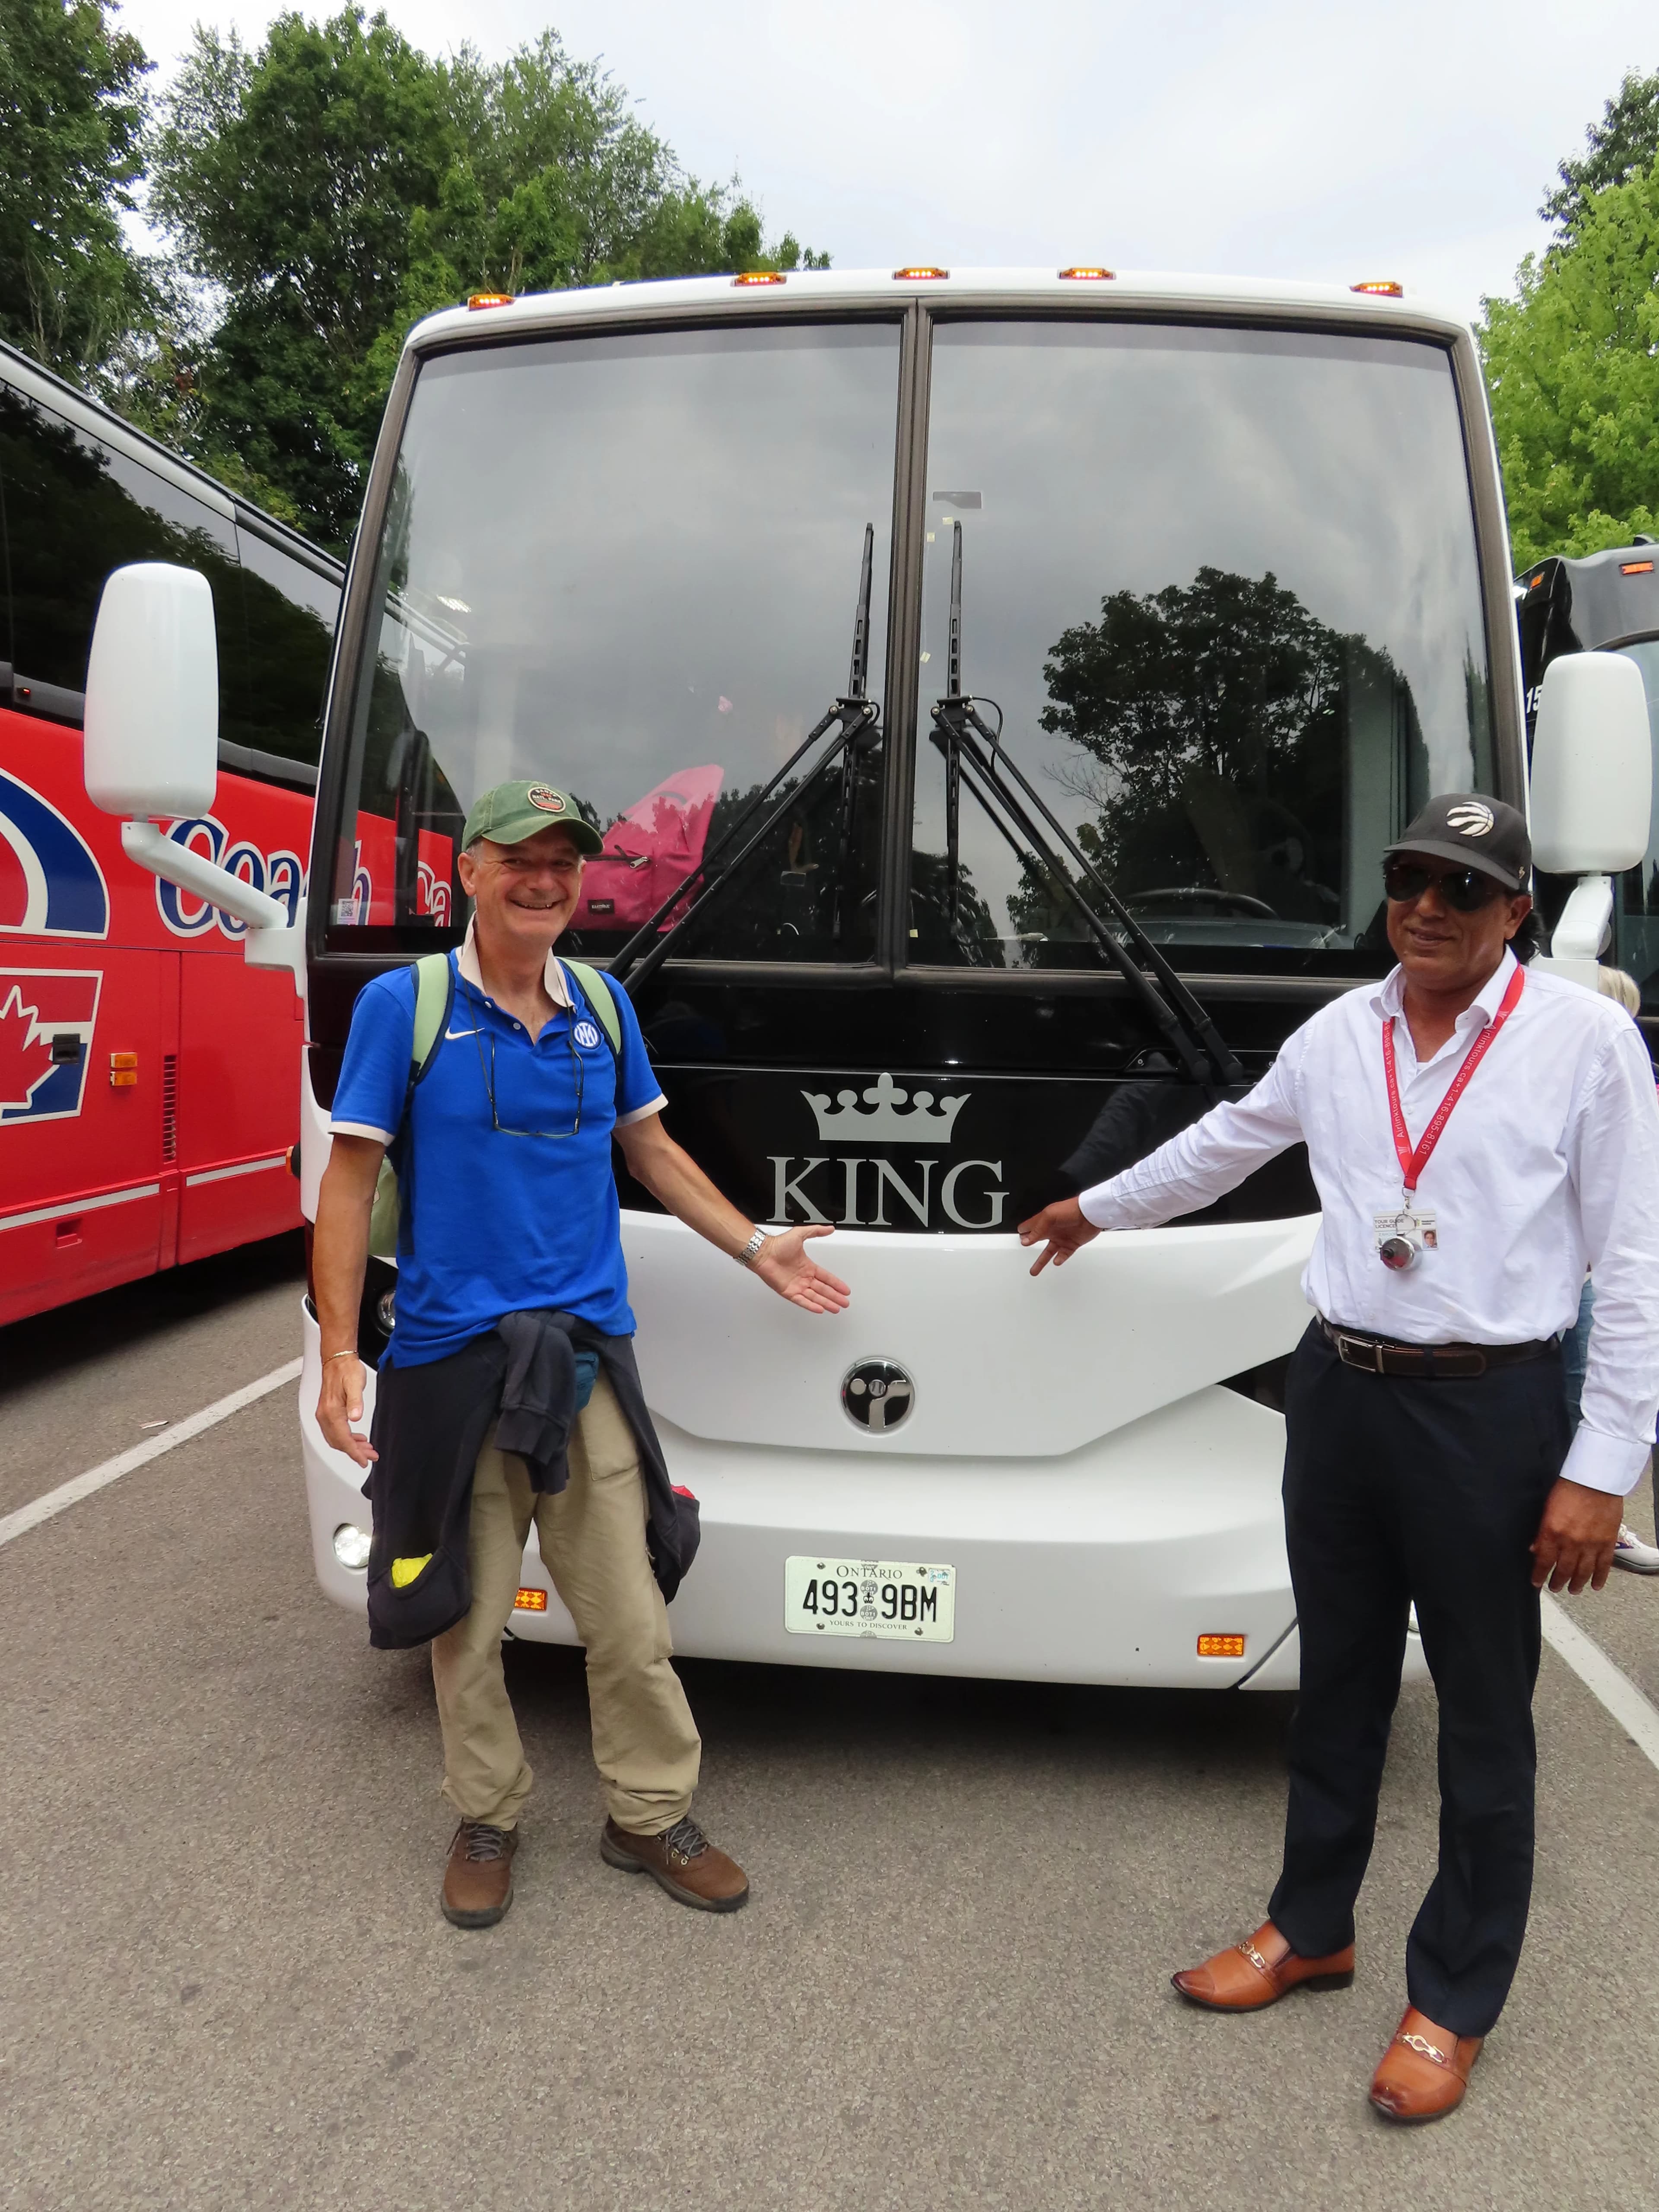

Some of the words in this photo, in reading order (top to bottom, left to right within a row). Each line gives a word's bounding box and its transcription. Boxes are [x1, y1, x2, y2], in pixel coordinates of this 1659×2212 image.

[155, 814, 372, 941] Coah
[766, 1156, 1010, 1229] KING
[803, 1580, 858, 1617] 493
[882, 1584, 937, 1622] 9BM
[836, 1565, 903, 1580] ONTARIO
